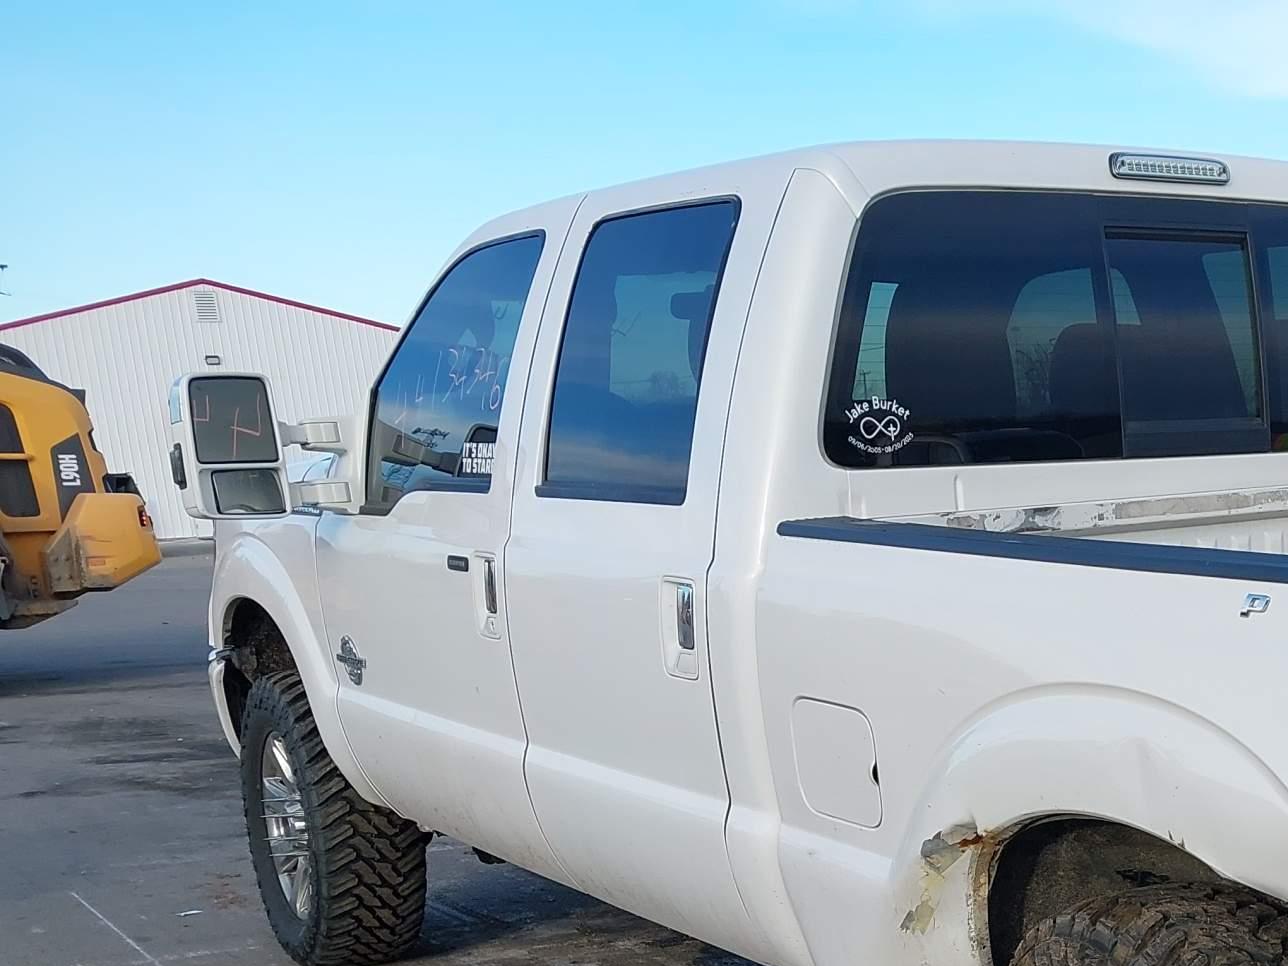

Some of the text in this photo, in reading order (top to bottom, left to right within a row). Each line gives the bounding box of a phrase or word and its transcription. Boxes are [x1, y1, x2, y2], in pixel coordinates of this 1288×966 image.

[844, 395, 911, 424] Jake Burket
[462, 442, 477, 458] IT'S
[57, 454, 81, 486] L90H
[462, 458, 472, 473] TO
